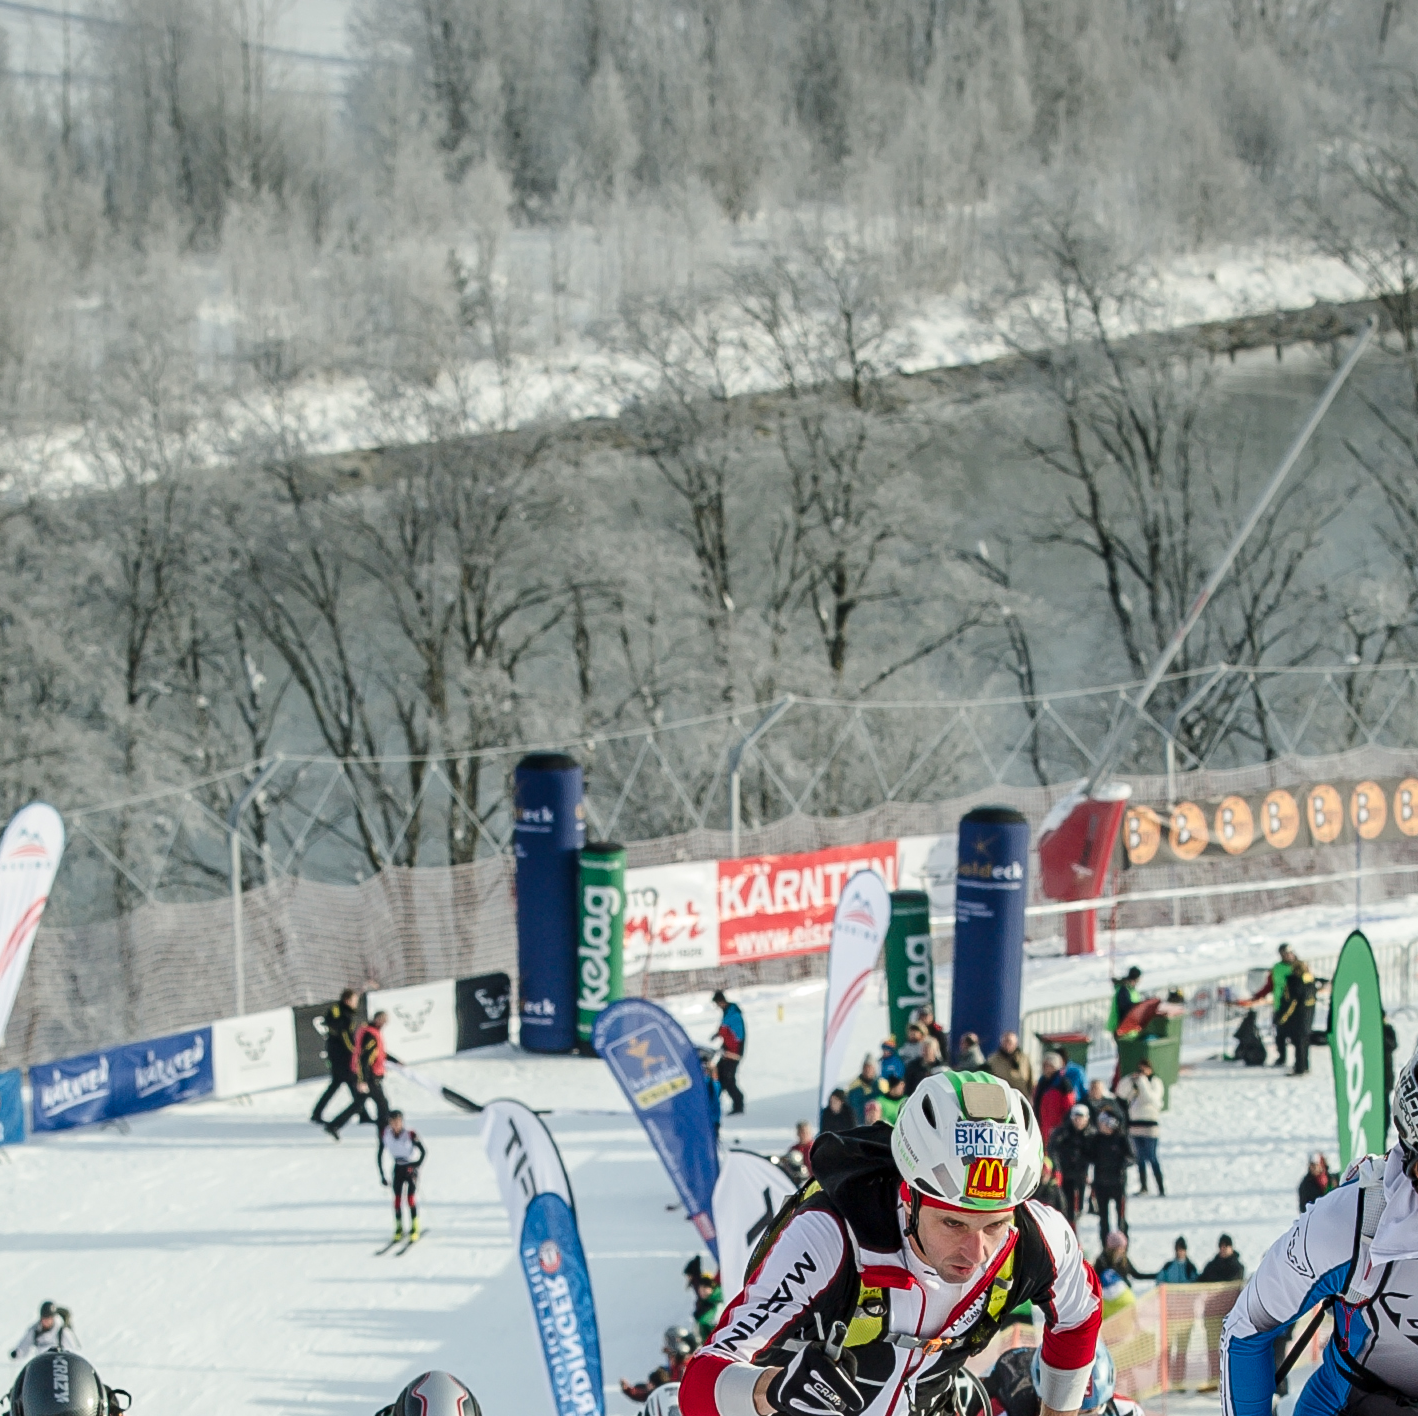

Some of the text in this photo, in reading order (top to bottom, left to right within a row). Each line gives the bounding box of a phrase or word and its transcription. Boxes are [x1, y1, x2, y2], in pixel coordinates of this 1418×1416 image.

[577, 885, 621, 1011] kelag
[954, 1128, 1019, 1147] BIKING
[955, 1144, 1019, 1159] HOLIDAYS
[712, 1251, 818, 1354] MARTINI
[963, 1309, 982, 1327] TEAM
